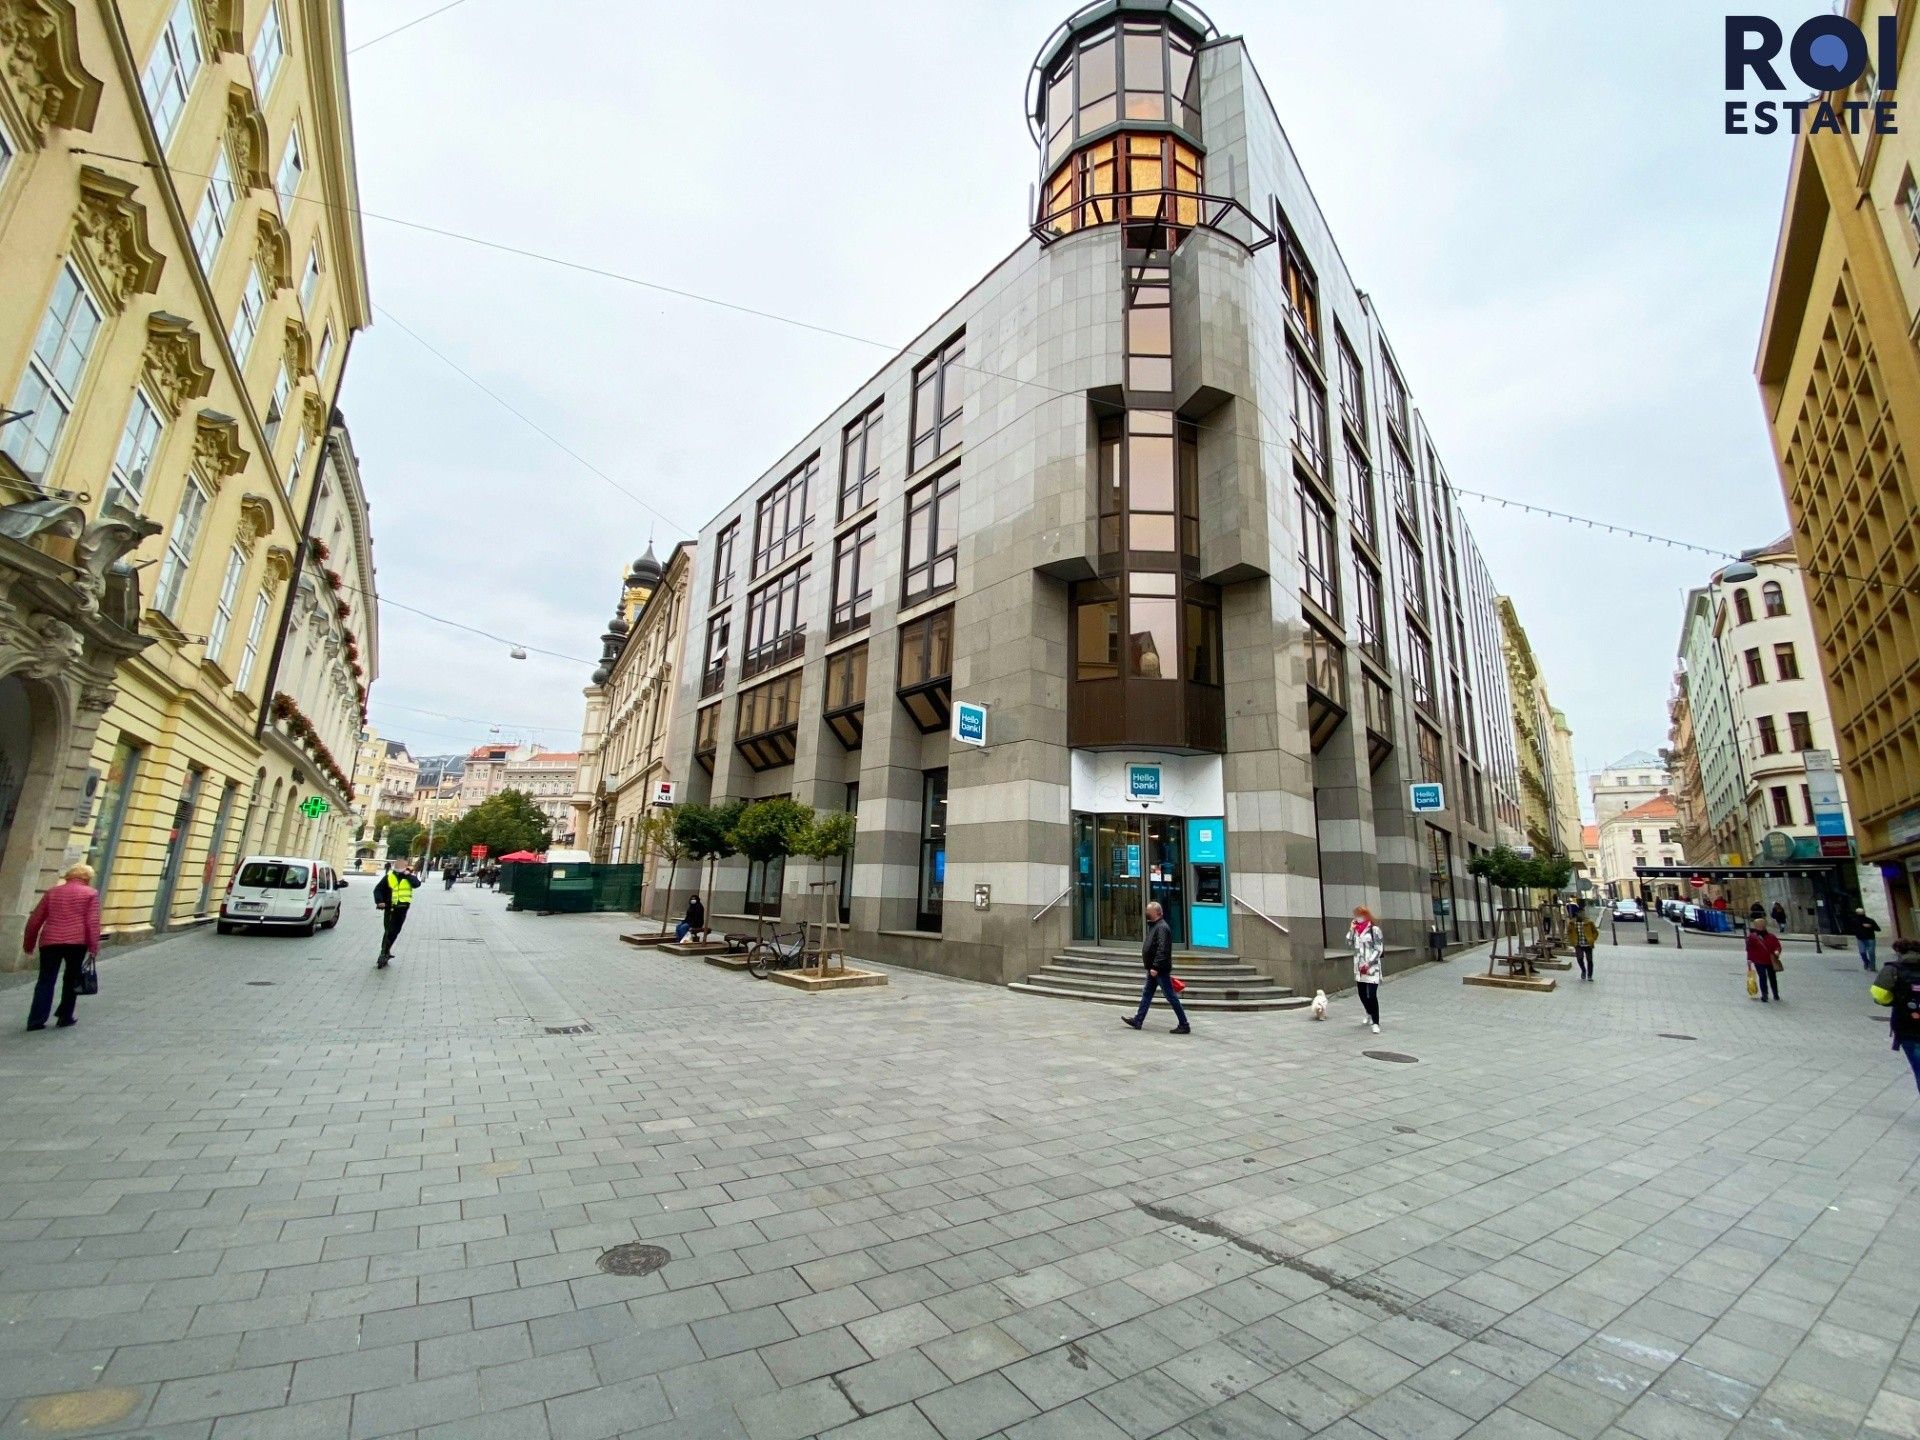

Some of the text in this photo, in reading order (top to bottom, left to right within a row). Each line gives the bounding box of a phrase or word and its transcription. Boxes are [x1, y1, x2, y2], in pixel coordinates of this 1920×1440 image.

[961, 713, 979, 724] Hello
[961, 722, 981, 733] bank!
[1132, 773, 1155, 781] Hello
[1132, 781, 1158, 789] bank!
